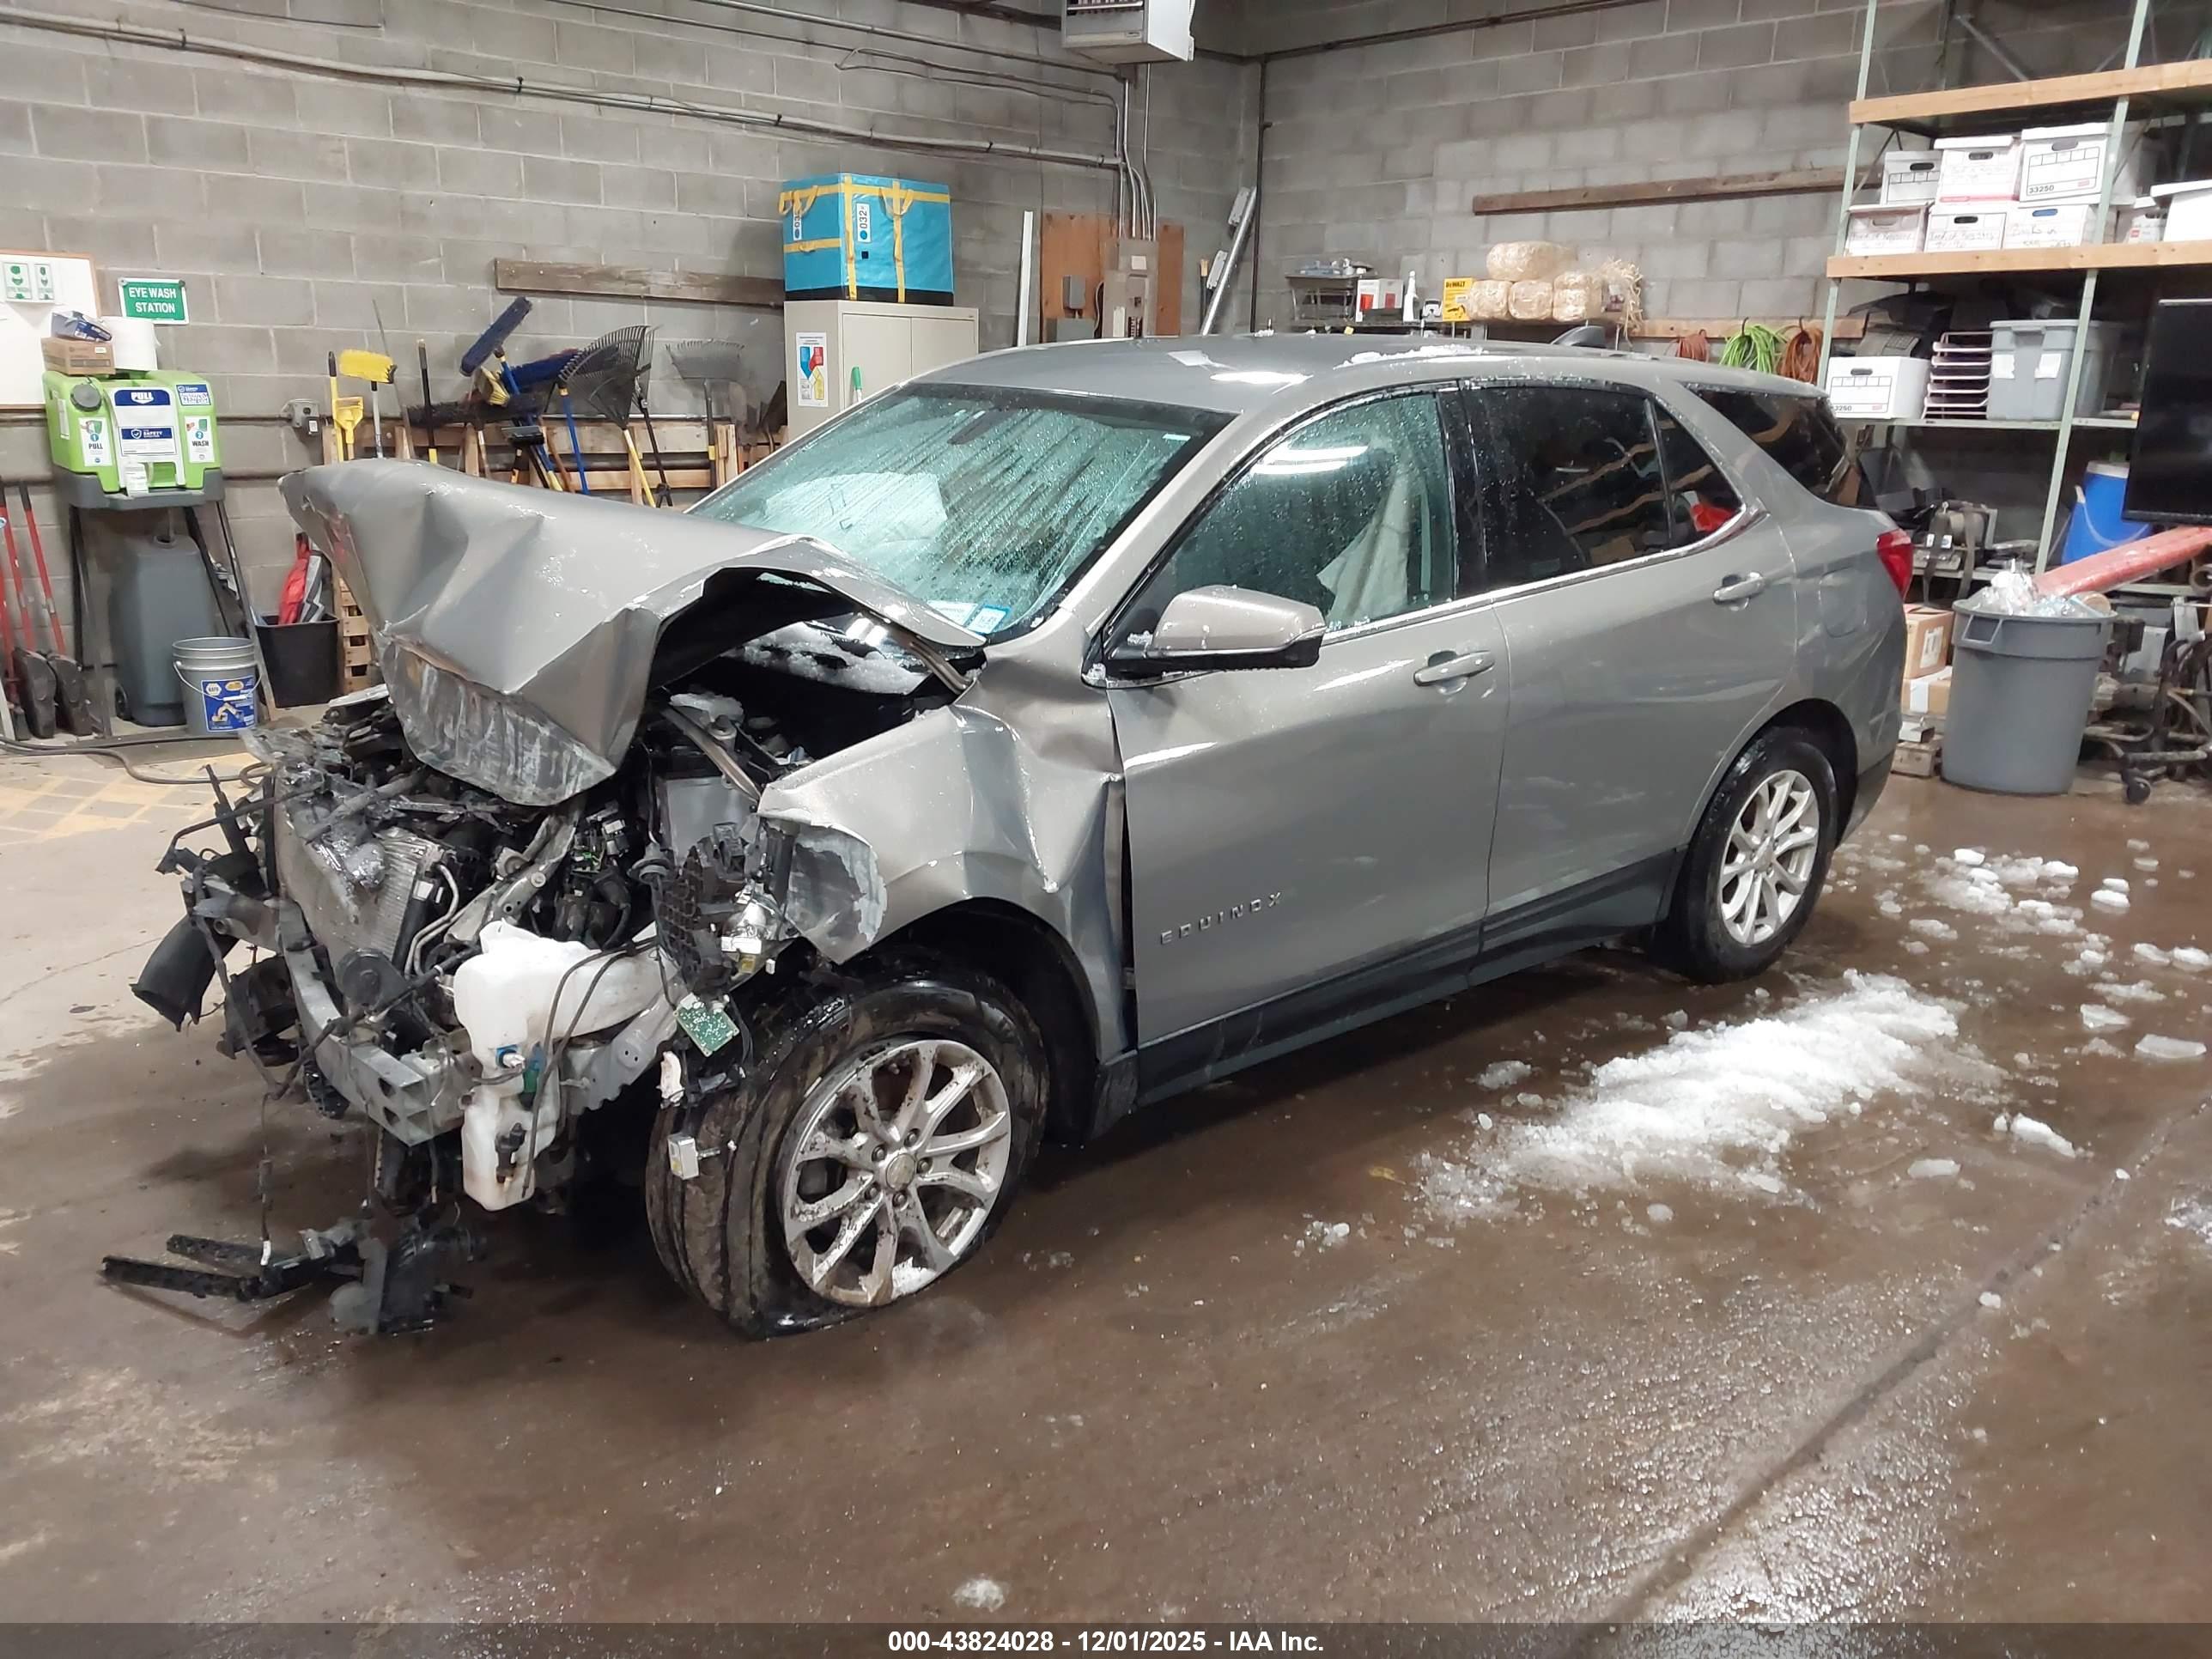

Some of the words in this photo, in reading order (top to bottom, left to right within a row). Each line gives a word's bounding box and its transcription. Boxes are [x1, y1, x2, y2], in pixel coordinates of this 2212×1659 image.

[2029, 185, 2054, 194] 33250
[859, 210, 868, 228] 032
[128, 287, 148, 298] EYE
[148, 287, 177, 299] WASH
[135, 301, 176, 313] STATION
[131, 392, 153, 401] PULL
[1160, 891, 1282, 945] EQUINOX
